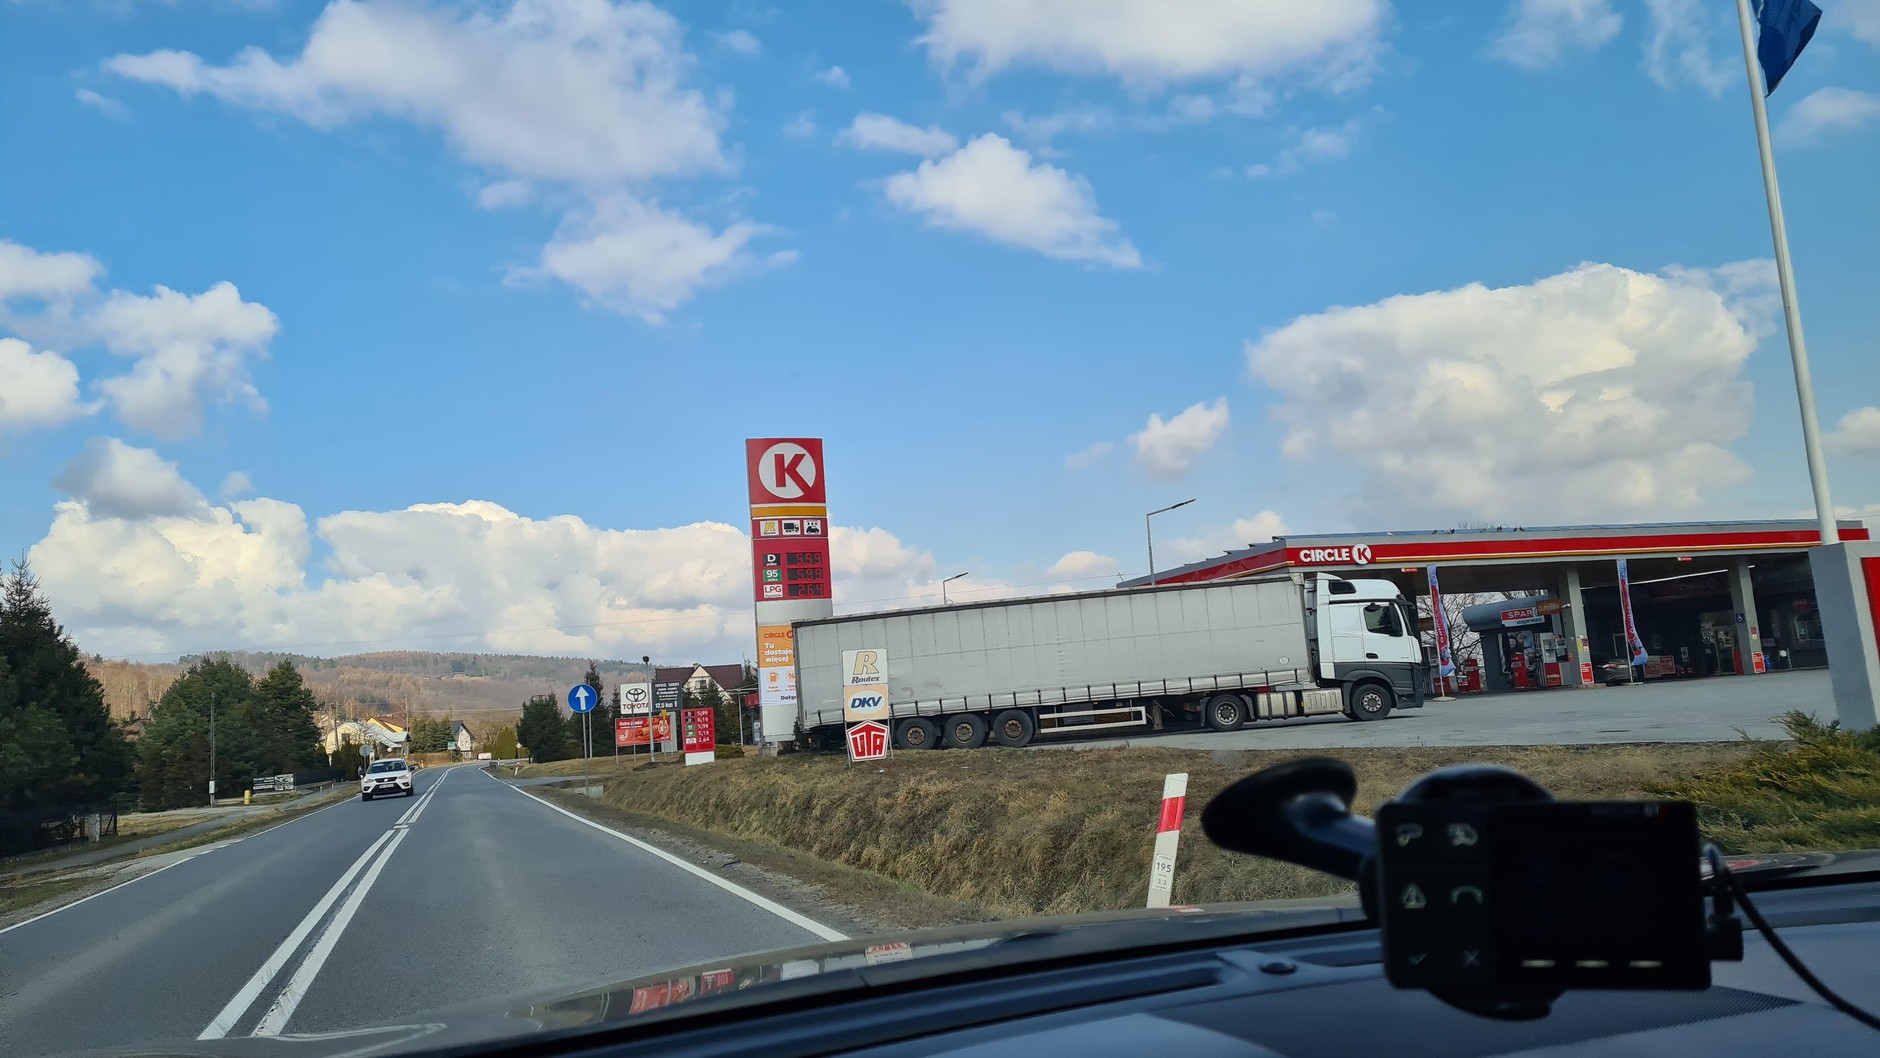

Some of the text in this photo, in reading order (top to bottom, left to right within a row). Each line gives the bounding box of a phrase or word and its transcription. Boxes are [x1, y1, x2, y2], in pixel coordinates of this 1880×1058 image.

[772, 452, 814, 496] K
[767, 554, 776, 562] D
[1299, 545, 1371, 563] CIRCLE K
[766, 569, 778, 578] 95
[1507, 609, 1533, 619] SPAR
[1516, 617, 1543, 625] express
[765, 655, 789, 663] więcej
[853, 650, 880, 676] R
[851, 675, 881, 685] Routex
[850, 696, 882, 708] DKV
[850, 724, 886, 758] UTA
[1157, 862, 1171, 872] 195
